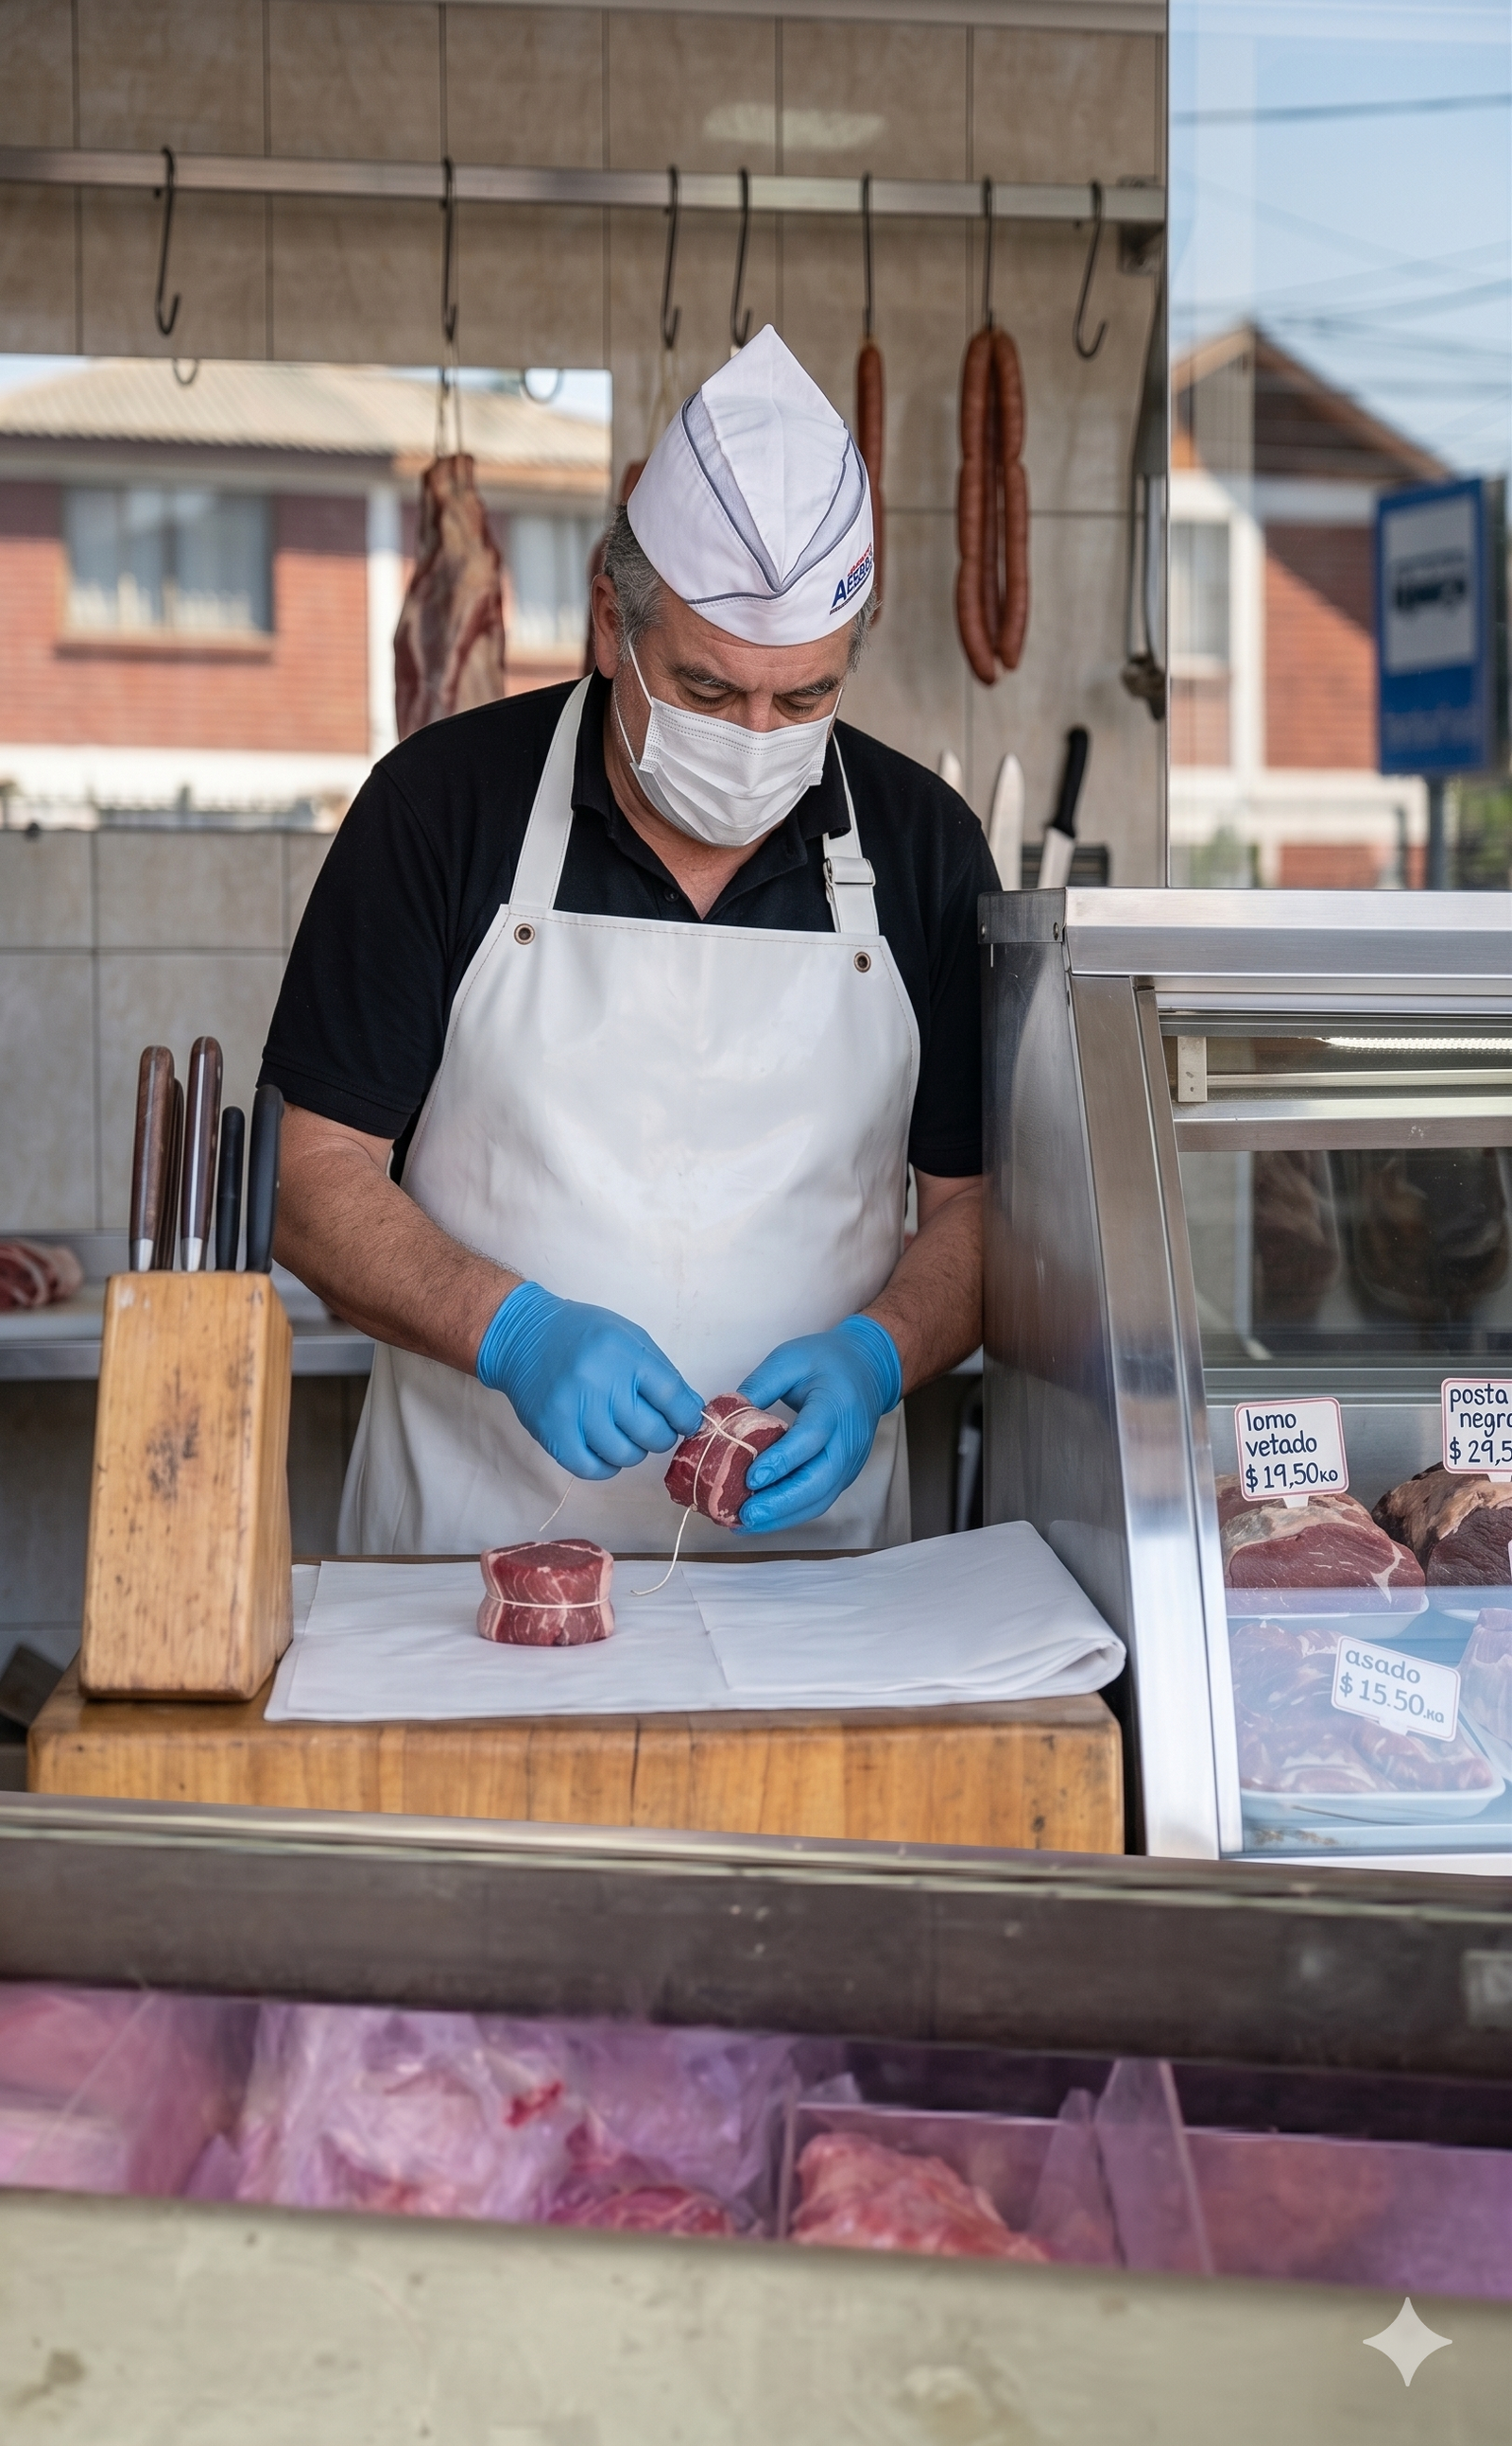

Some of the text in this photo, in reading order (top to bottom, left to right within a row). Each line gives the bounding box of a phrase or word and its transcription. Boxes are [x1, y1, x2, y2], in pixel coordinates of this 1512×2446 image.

[1450, 1383, 1509, 1412] posta
[1246, 1409, 1297, 1431] lomo
[1246, 1430, 1317, 1457] vetado
[1345, 1649, 1420, 1684] asado
